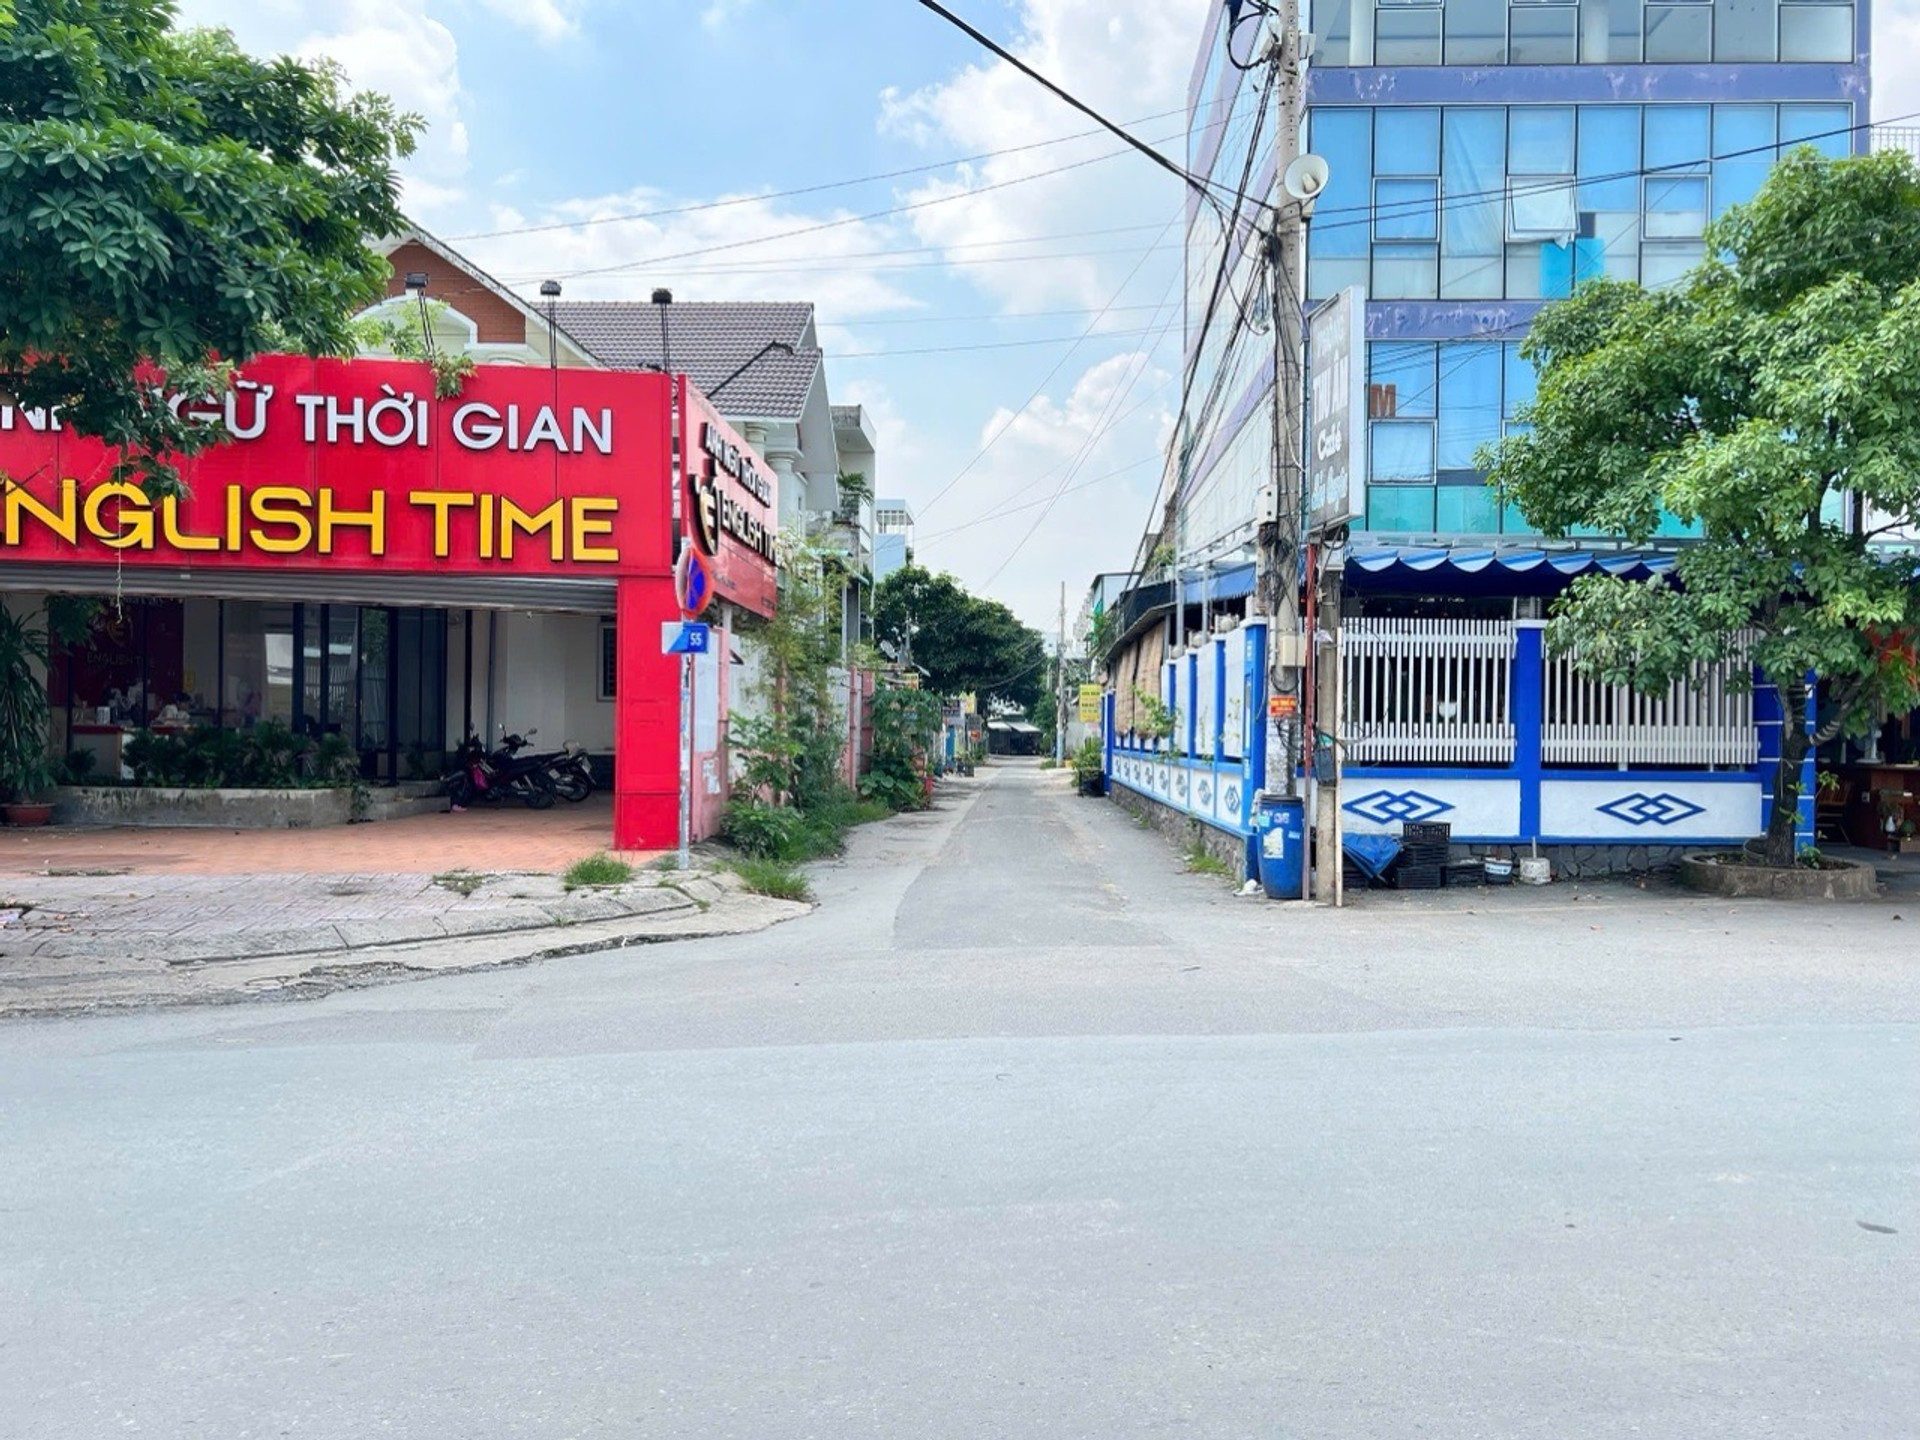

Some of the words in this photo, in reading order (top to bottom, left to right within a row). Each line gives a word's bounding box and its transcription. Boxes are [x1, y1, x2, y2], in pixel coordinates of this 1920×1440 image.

[152, 378, 274, 440] GỮ
[296, 383, 428, 446] THỜI
[451, 402, 612, 453] GIAN
[2, 478, 384, 553] NGLISH
[408, 490, 619, 562] TIME
